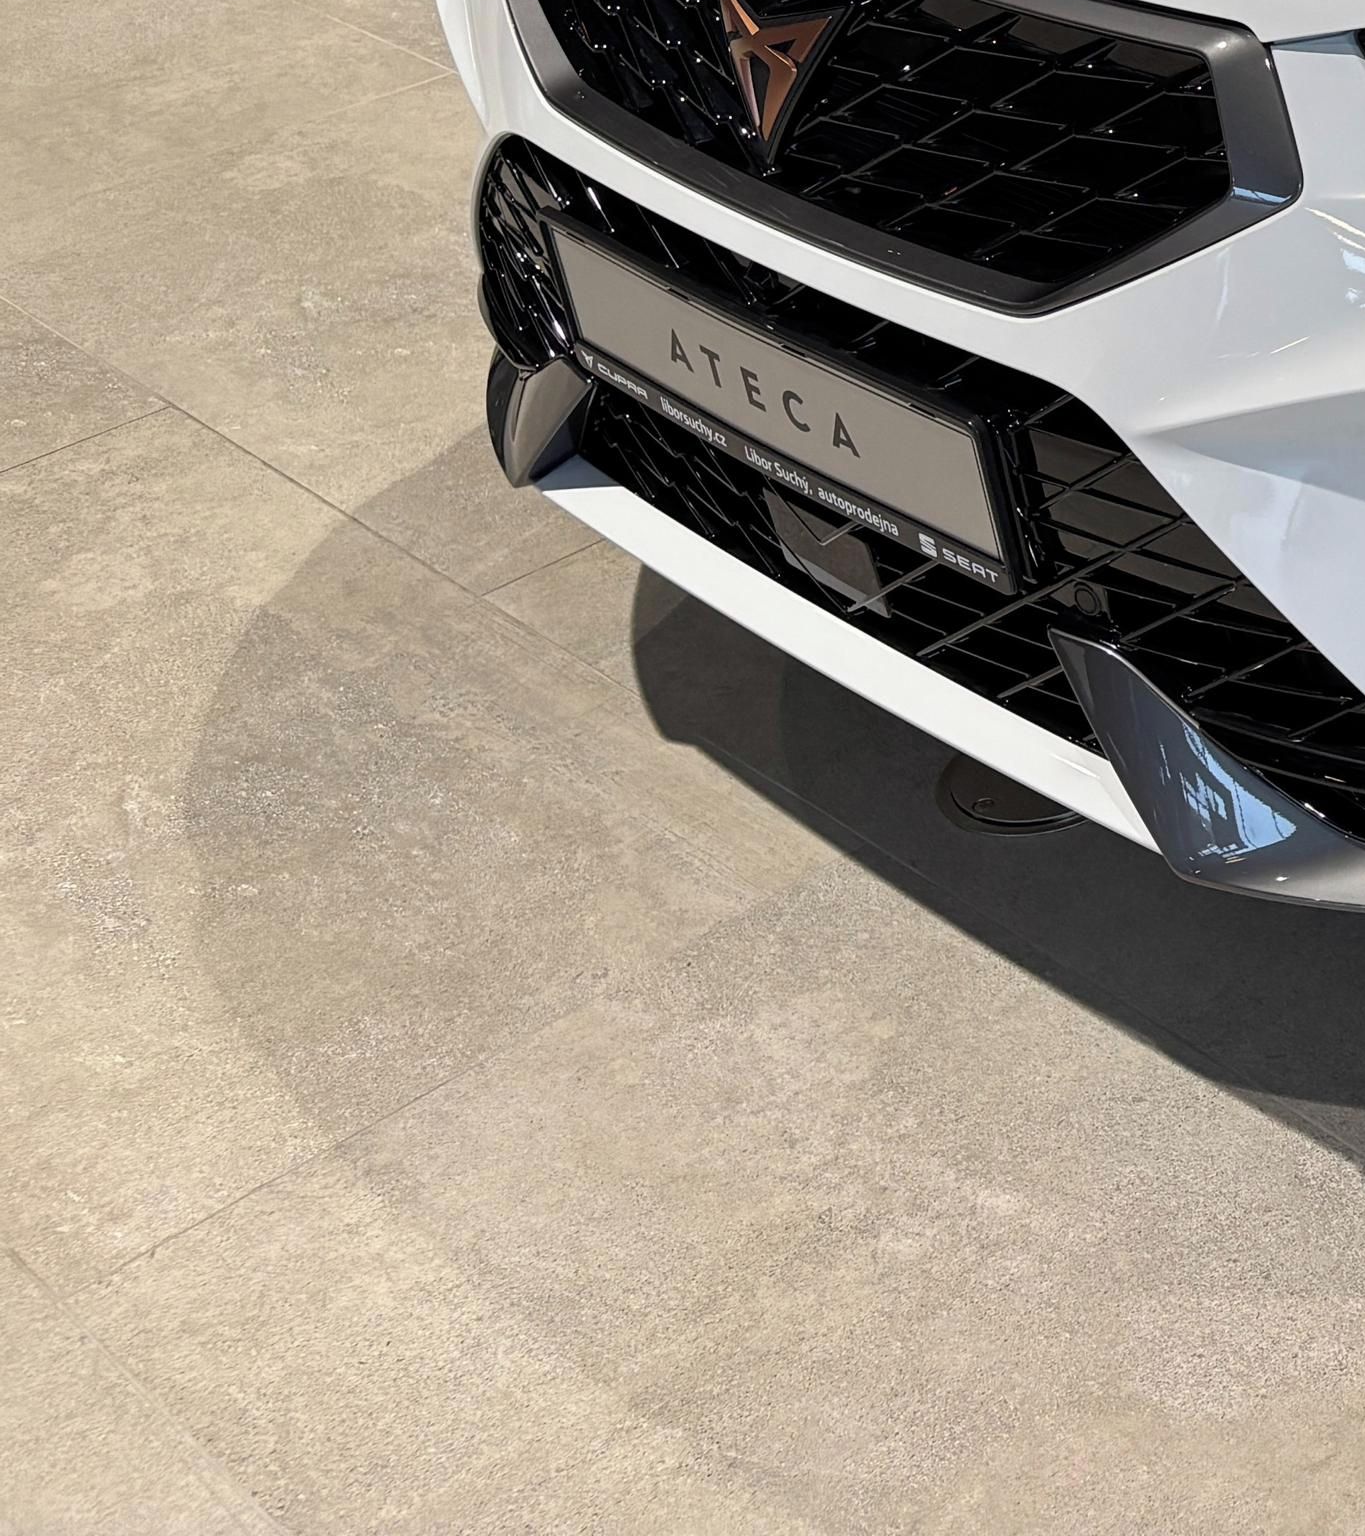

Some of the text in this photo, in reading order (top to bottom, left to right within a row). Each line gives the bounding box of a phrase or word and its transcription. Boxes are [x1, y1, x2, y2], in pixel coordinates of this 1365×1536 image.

[597, 363, 999, 584] CUPRA liborsuchy.cz Libor Suchý, autoprodejna SEAT
[670, 327, 860, 459] ATECA
